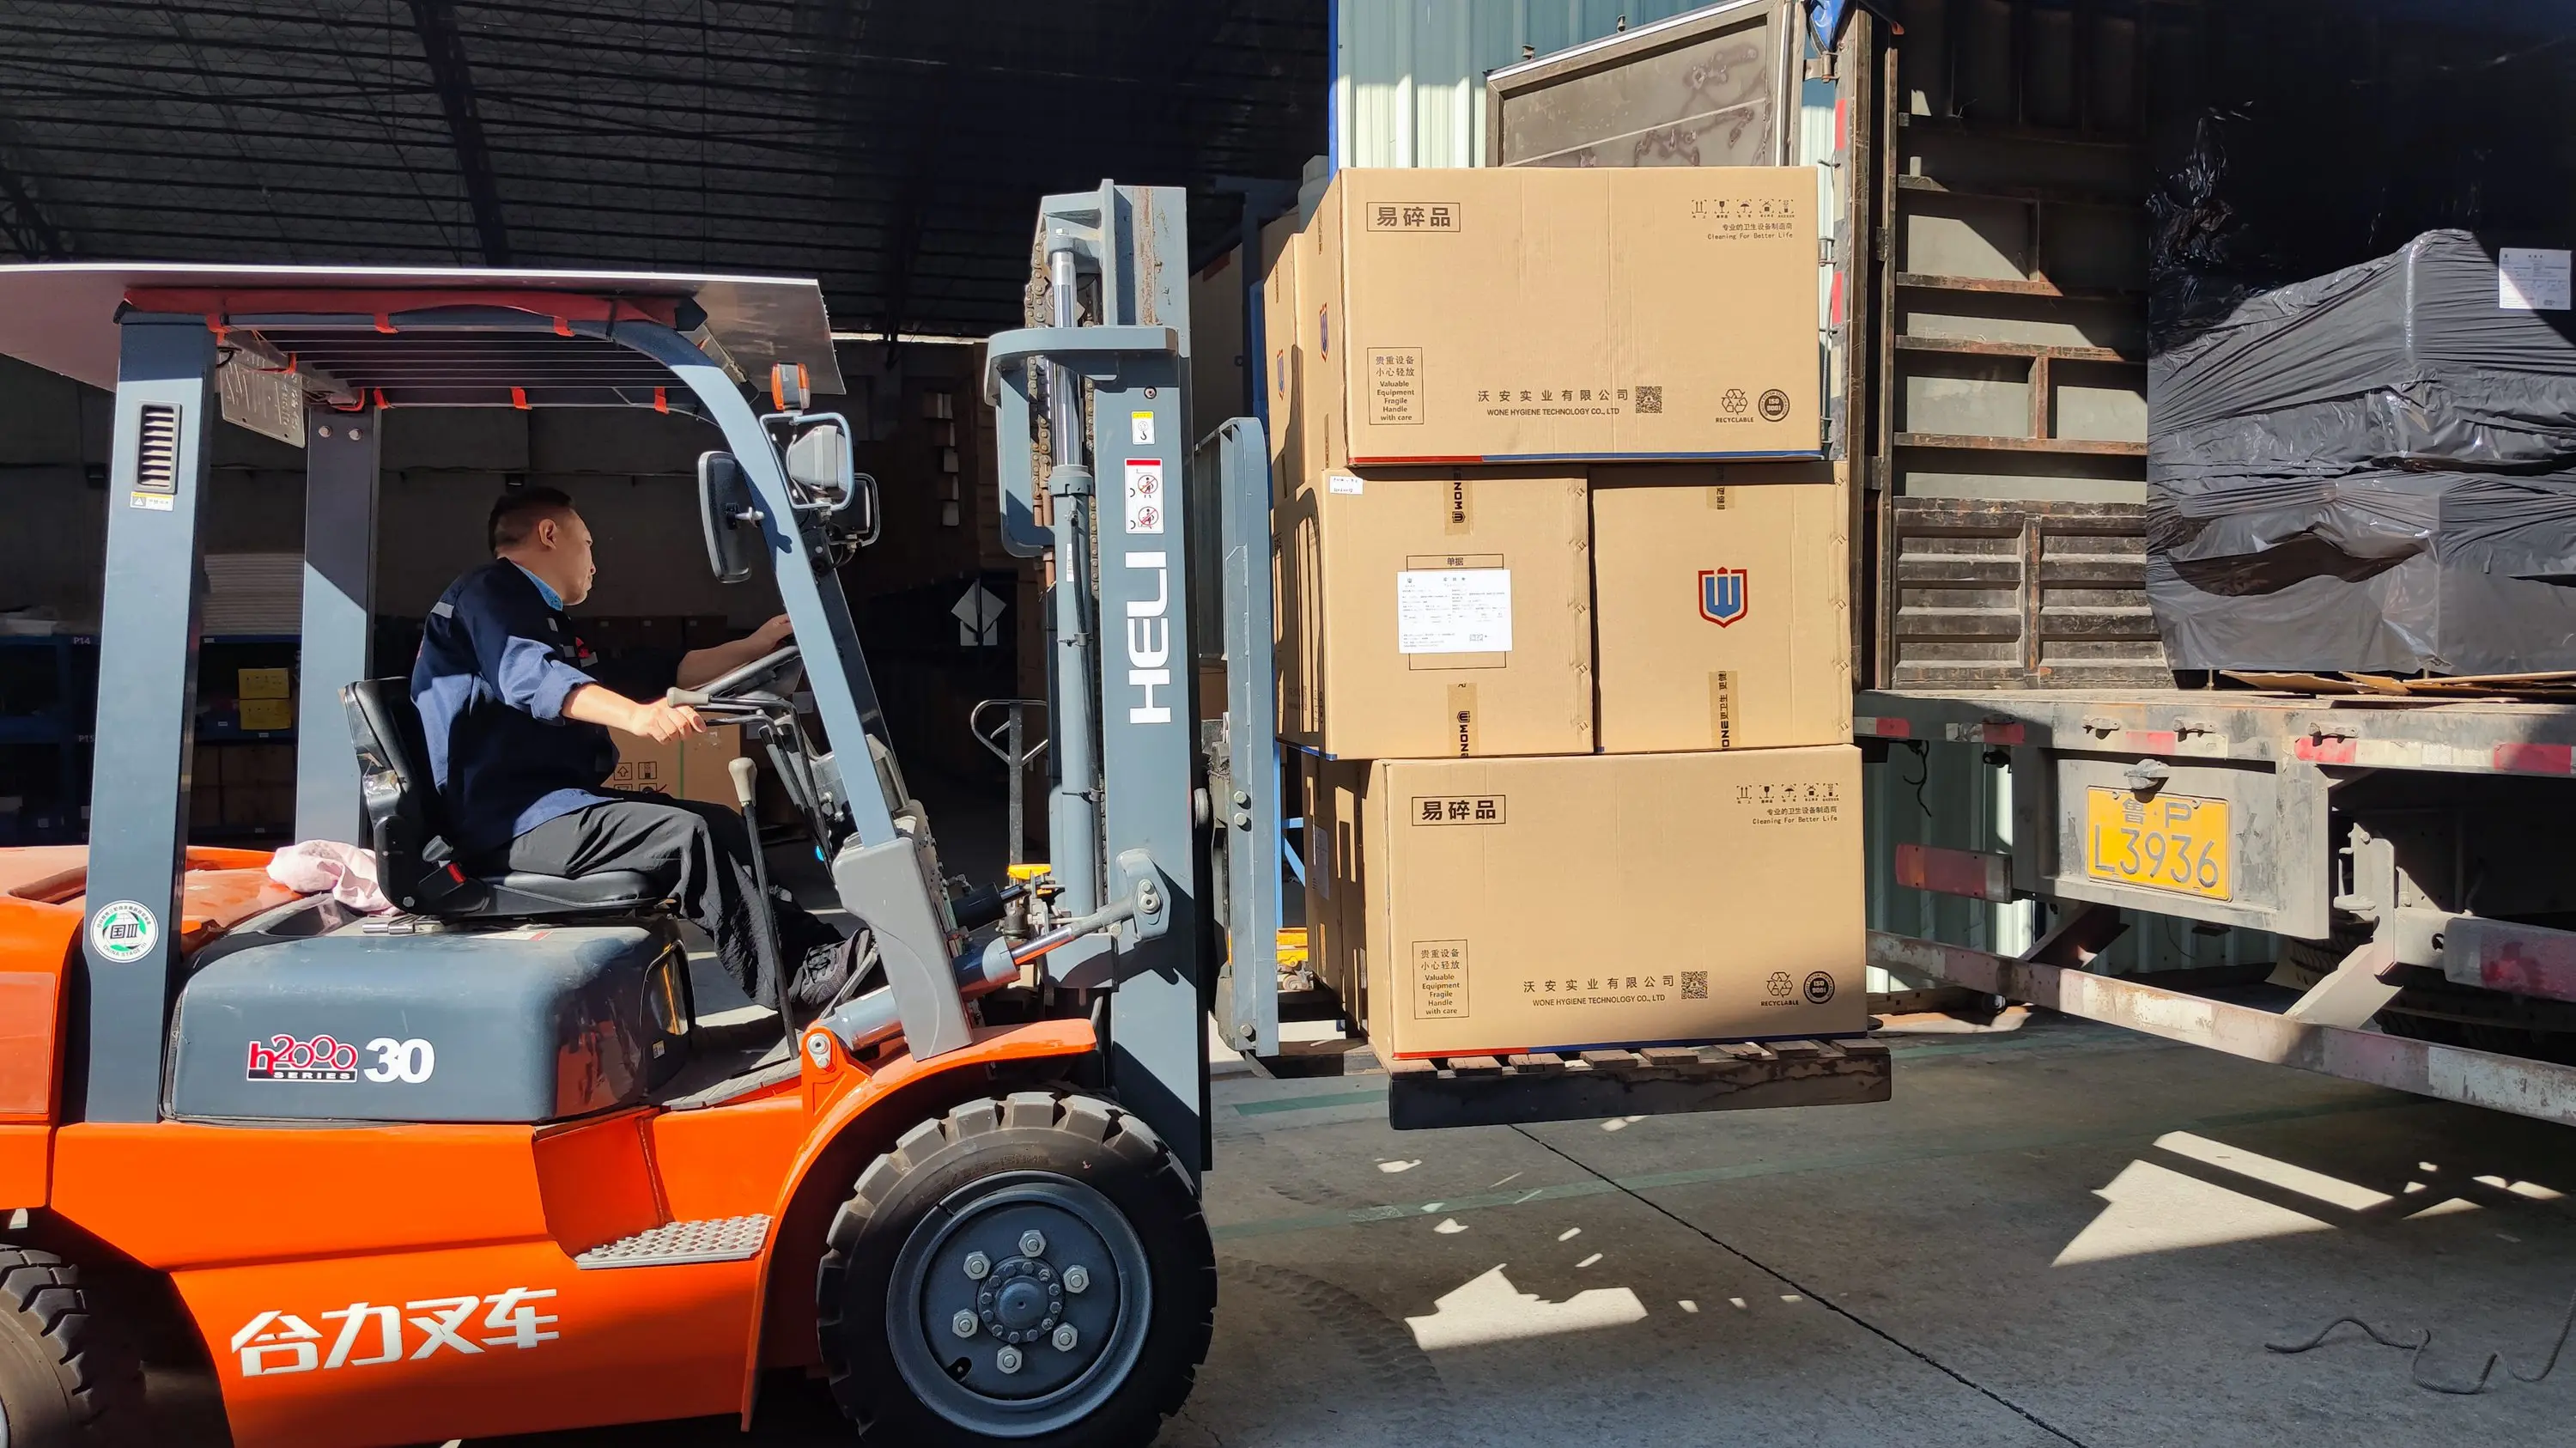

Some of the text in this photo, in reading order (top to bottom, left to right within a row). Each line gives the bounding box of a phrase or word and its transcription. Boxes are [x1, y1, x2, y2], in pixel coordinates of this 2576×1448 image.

[1377, 206, 1451, 228] 易碎品
[1376, 356, 1414, 365] 贵重设备
[1376, 367, 1415, 377] 小心轻放
[1376, 389, 1415, 398] Equipment
[1478, 389, 1628, 403] 沃安实业有限公司
[73, 636, 91, 645] P14
[1125, 551, 1172, 724] HELI
[1721, 721, 1730, 751] ONE
[1422, 800, 1497, 820] 易碎品
[1766, 806, 1838, 816] 专业的卫生设备制造商
[2094, 824, 2219, 888] L3936
[1420, 948, 1460, 959] 贵重设备
[1420, 960, 1461, 970] 小心轻放
[1523, 975, 1674, 993] 沃安实业有限公司
[1429, 990, 1453, 999] Fragile
[1588, 995, 1635, 1004] TECHNOLOGY
[363, 1037, 435, 1084] 30
[273, 1071, 351, 1080] SERIES
[230, 1287, 560, 1378] 合力叉车
